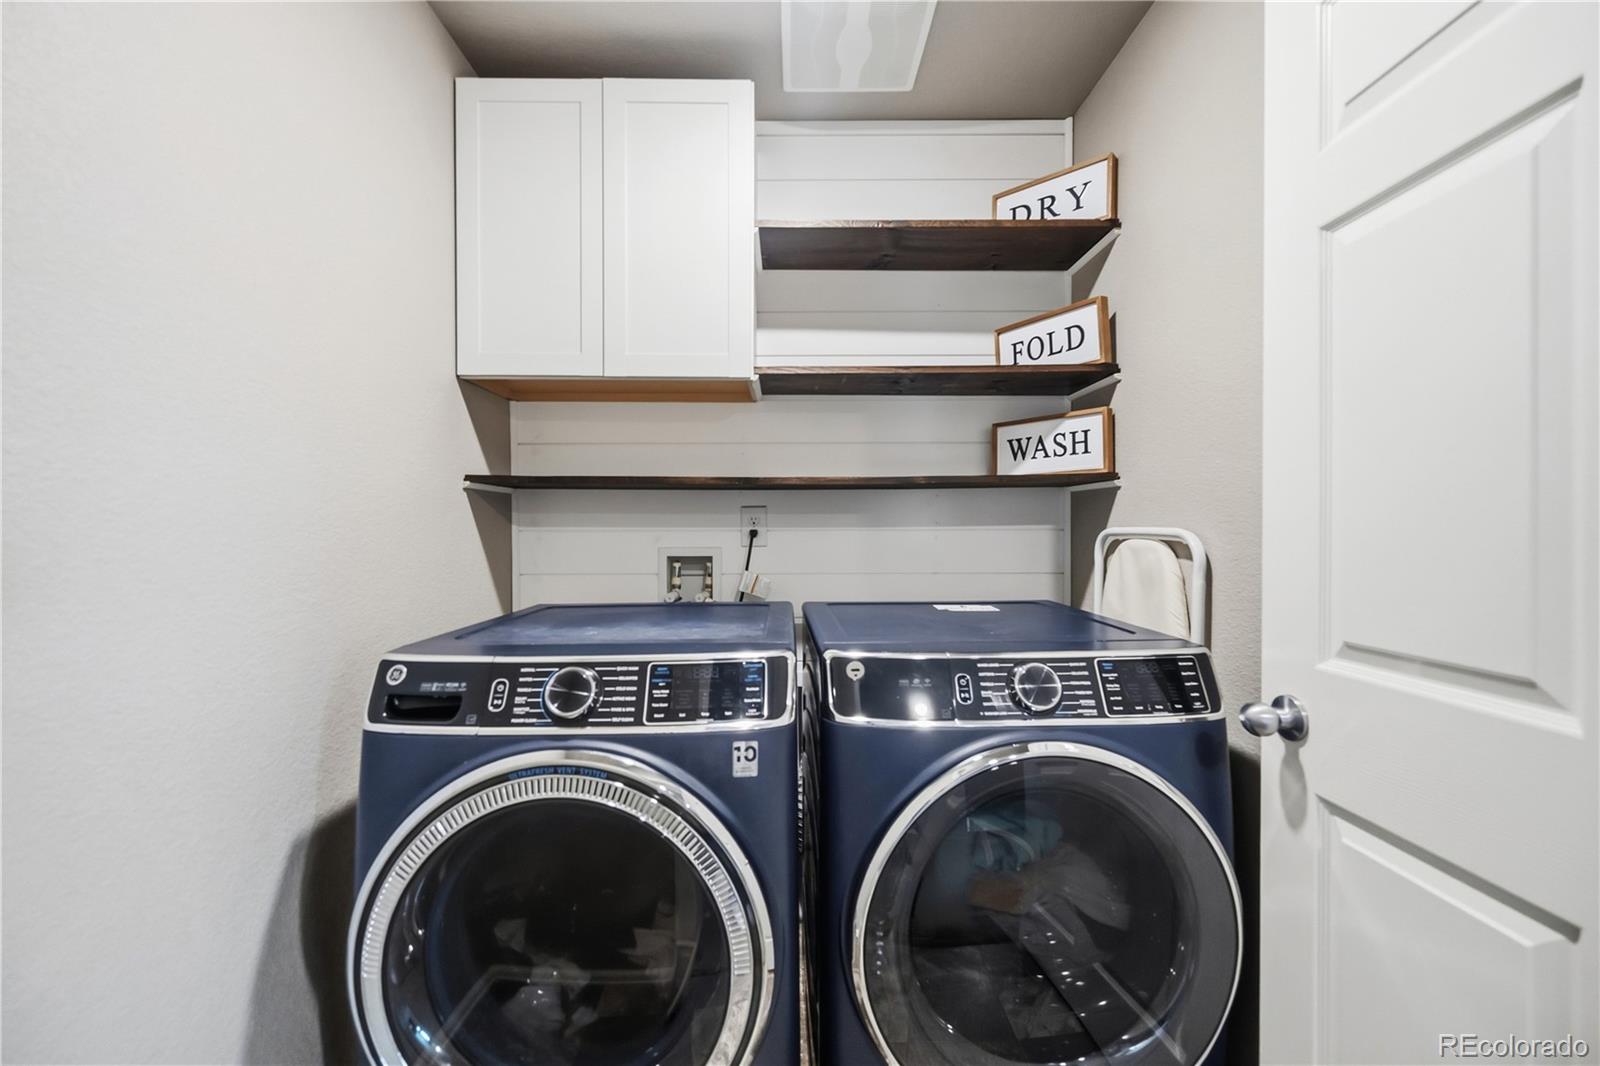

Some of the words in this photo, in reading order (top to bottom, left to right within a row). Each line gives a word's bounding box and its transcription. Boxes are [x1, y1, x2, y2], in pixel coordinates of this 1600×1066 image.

[1009, 180, 1092, 220] DRY
[1010, 324, 1085, 365] FOLD
[1007, 429, 1091, 461] WASH
[557, 766, 576, 775] VENT
[579, 767, 608, 779] SYSTEM
